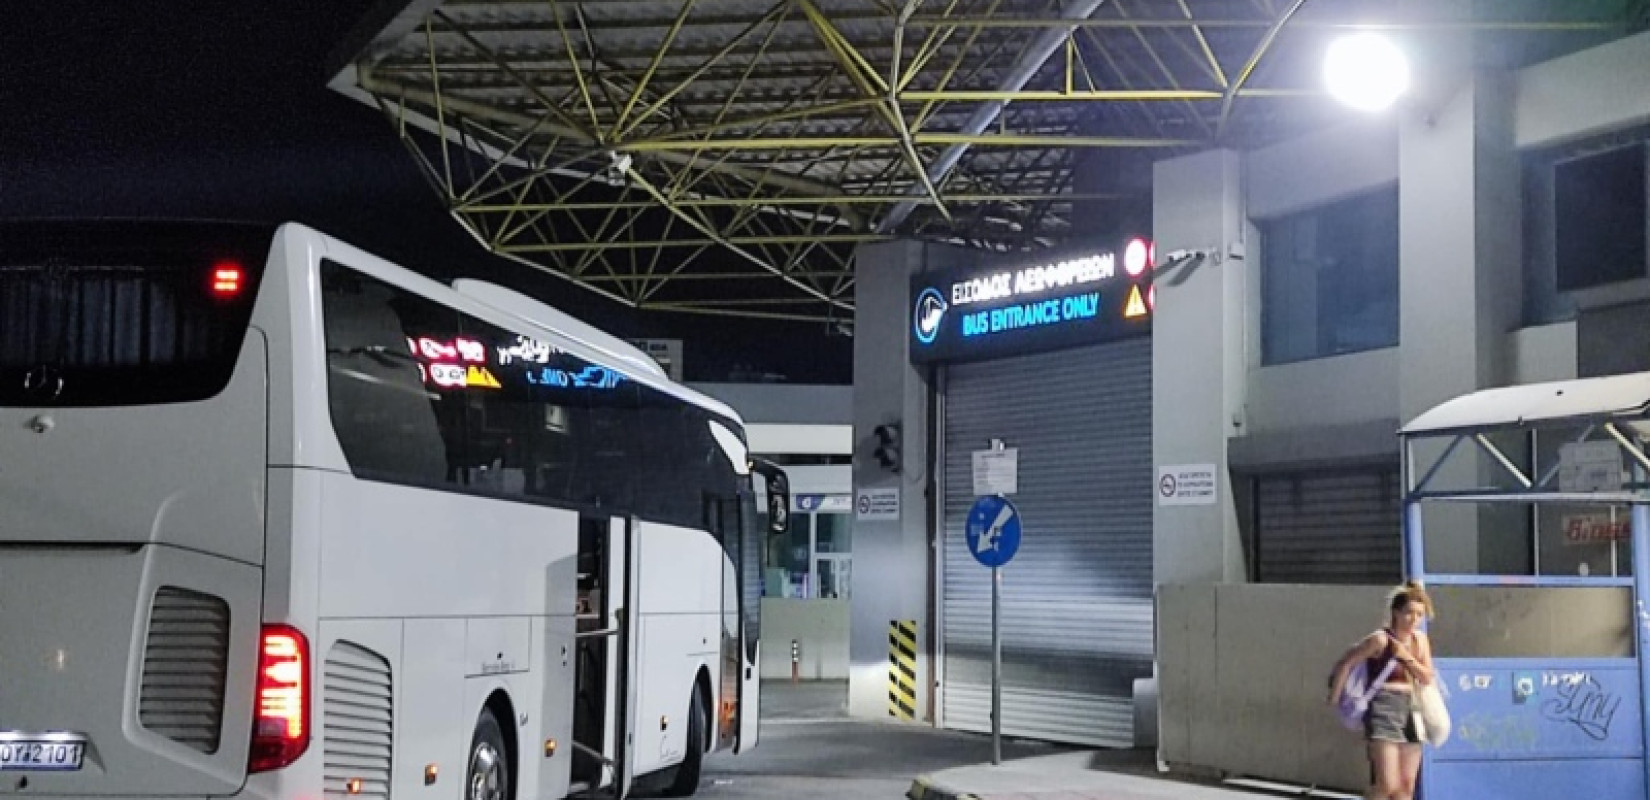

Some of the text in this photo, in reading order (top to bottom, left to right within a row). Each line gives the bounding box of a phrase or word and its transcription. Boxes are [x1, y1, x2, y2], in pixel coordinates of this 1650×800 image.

[963, 292, 1099, 336] BUS ENTRANCE ONLY
